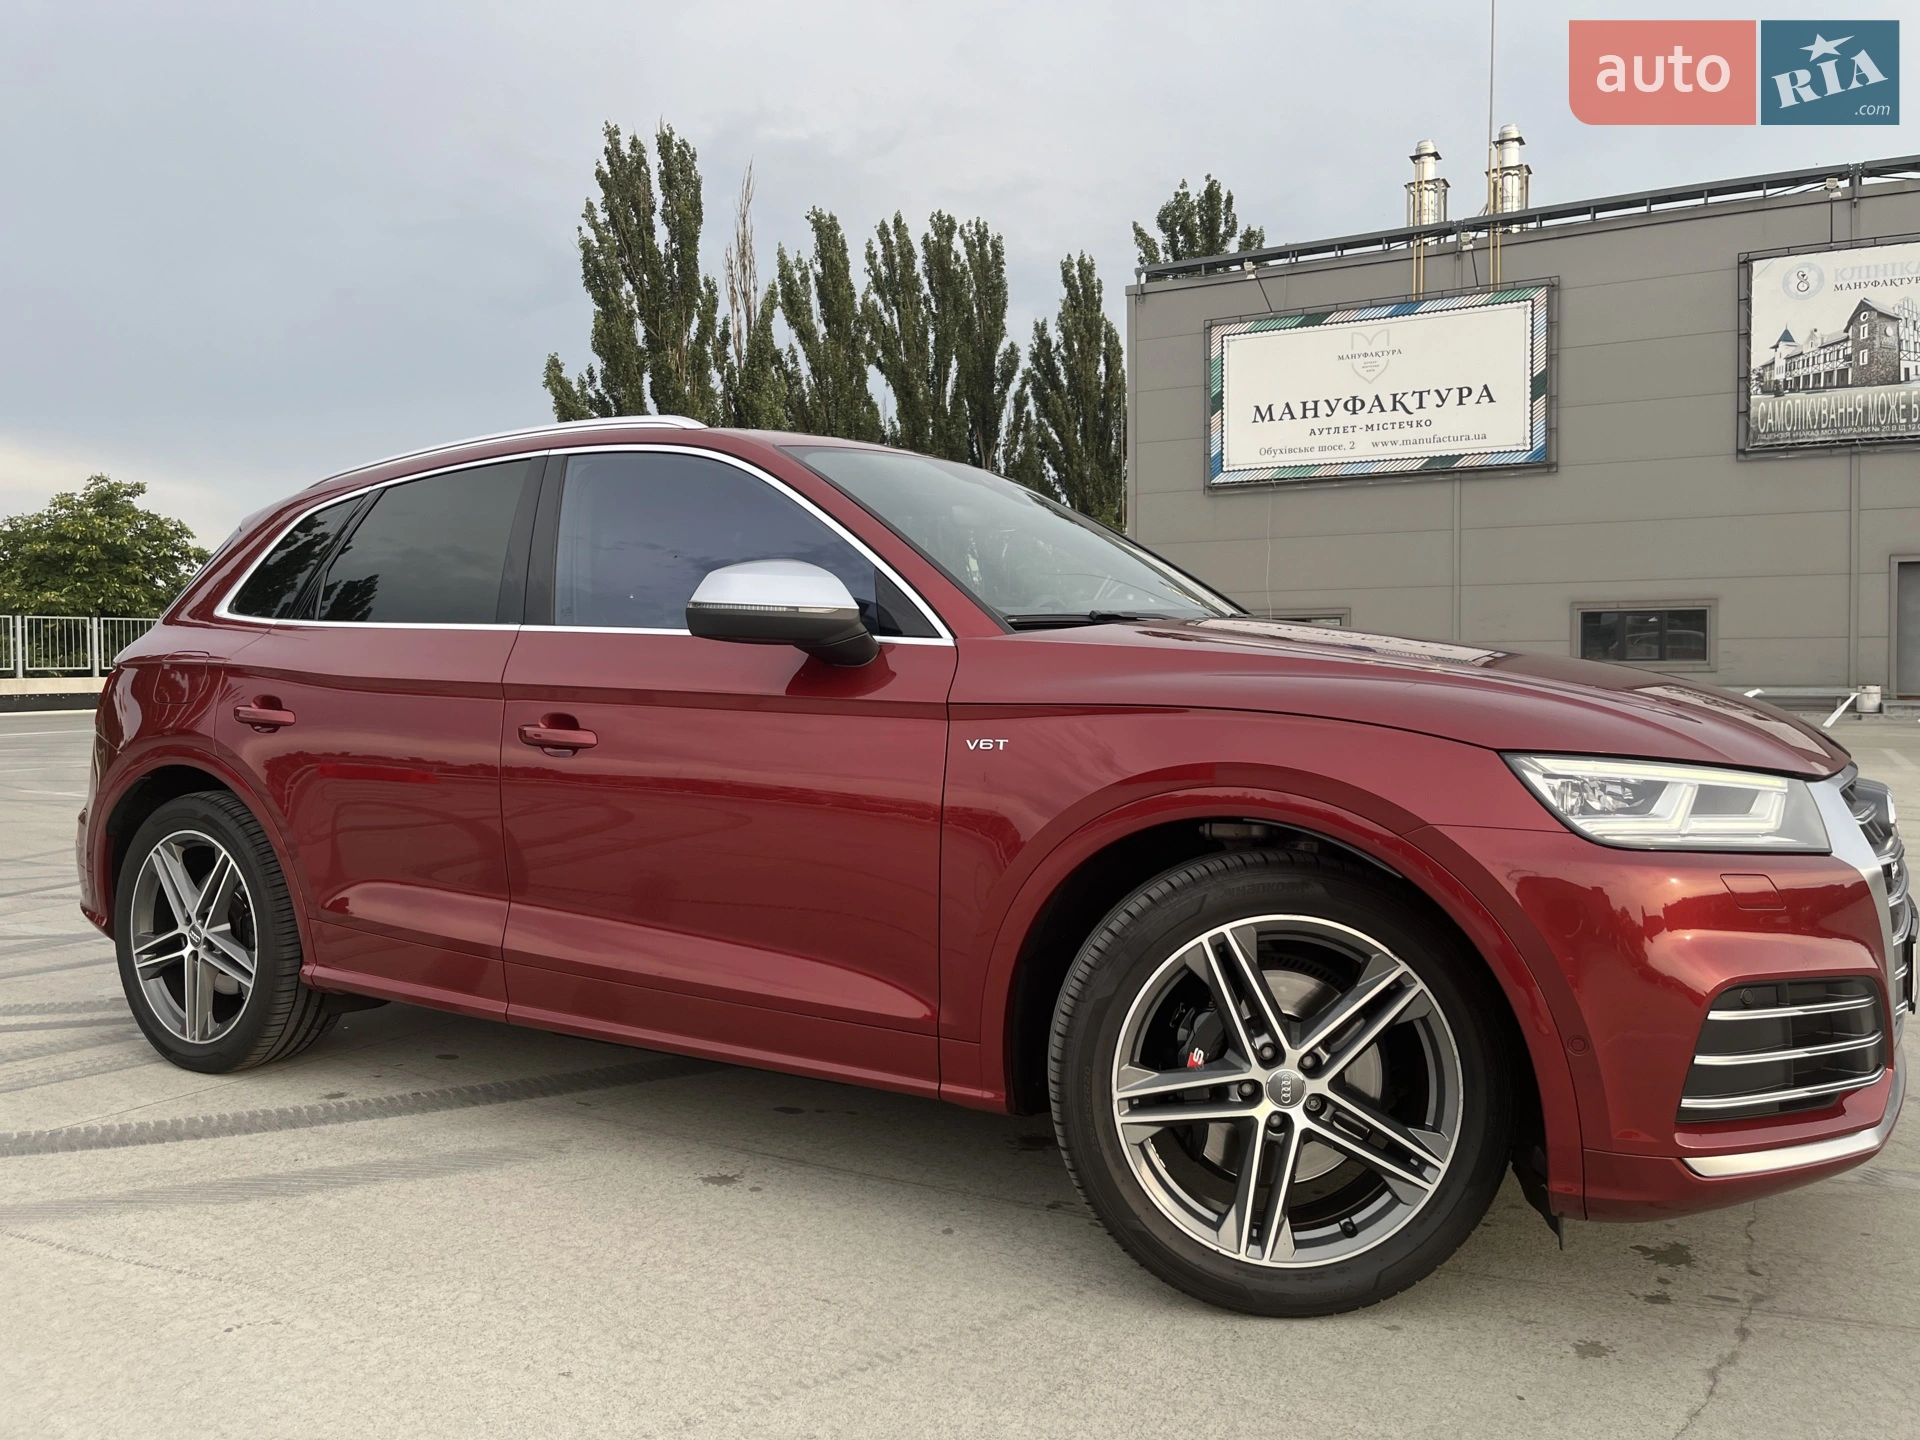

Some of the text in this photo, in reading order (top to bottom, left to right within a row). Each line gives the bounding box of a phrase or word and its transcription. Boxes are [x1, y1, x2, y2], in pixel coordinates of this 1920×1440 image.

[1337, 348, 1403, 361] МАНУФАКТУРА
[1251, 384, 1496, 424] МАНУФАКТУРА
[1757, 394, 1863, 433] САМОЛІКУВАННЯ
[1868, 391, 1906, 425] МОЖЕ
[1309, 419, 1433, 437] АУТЛЕТ-МІСТЕЧКО
[1839, 427, 1870, 435] УКРАЇНИ
[1881, 425, 1890, 434] 20
[1259, 446, 1315, 458] Обухівське
[1349, 441, 1356, 450] 2
[1371, 431, 1488, 449] www.manufactura.ua
[966, 739, 1009, 750] V6T
